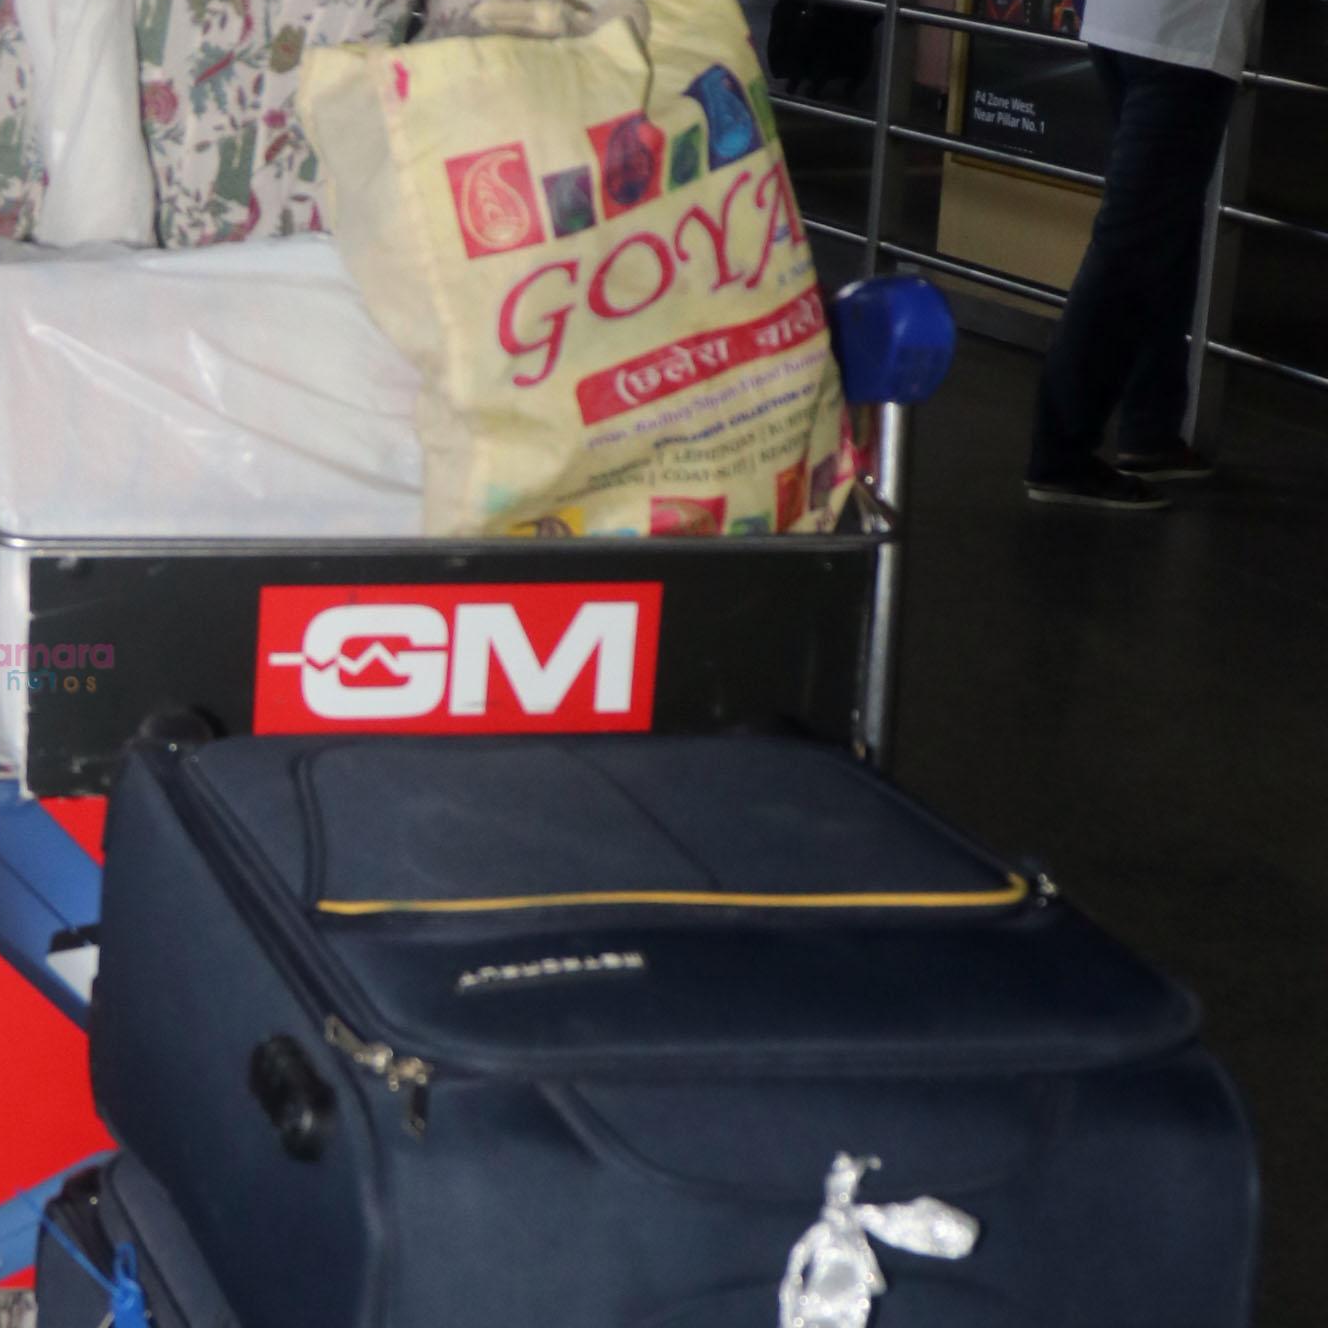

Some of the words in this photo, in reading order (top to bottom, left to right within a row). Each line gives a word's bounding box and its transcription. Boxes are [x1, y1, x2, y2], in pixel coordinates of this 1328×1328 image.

[987, 93, 1010, 109] Zone
[974, 107, 995, 122] Near
[996, 111, 1020, 128] Pillar
[1022, 117, 1038, 132] No.
[269, 601, 639, 721] GM
